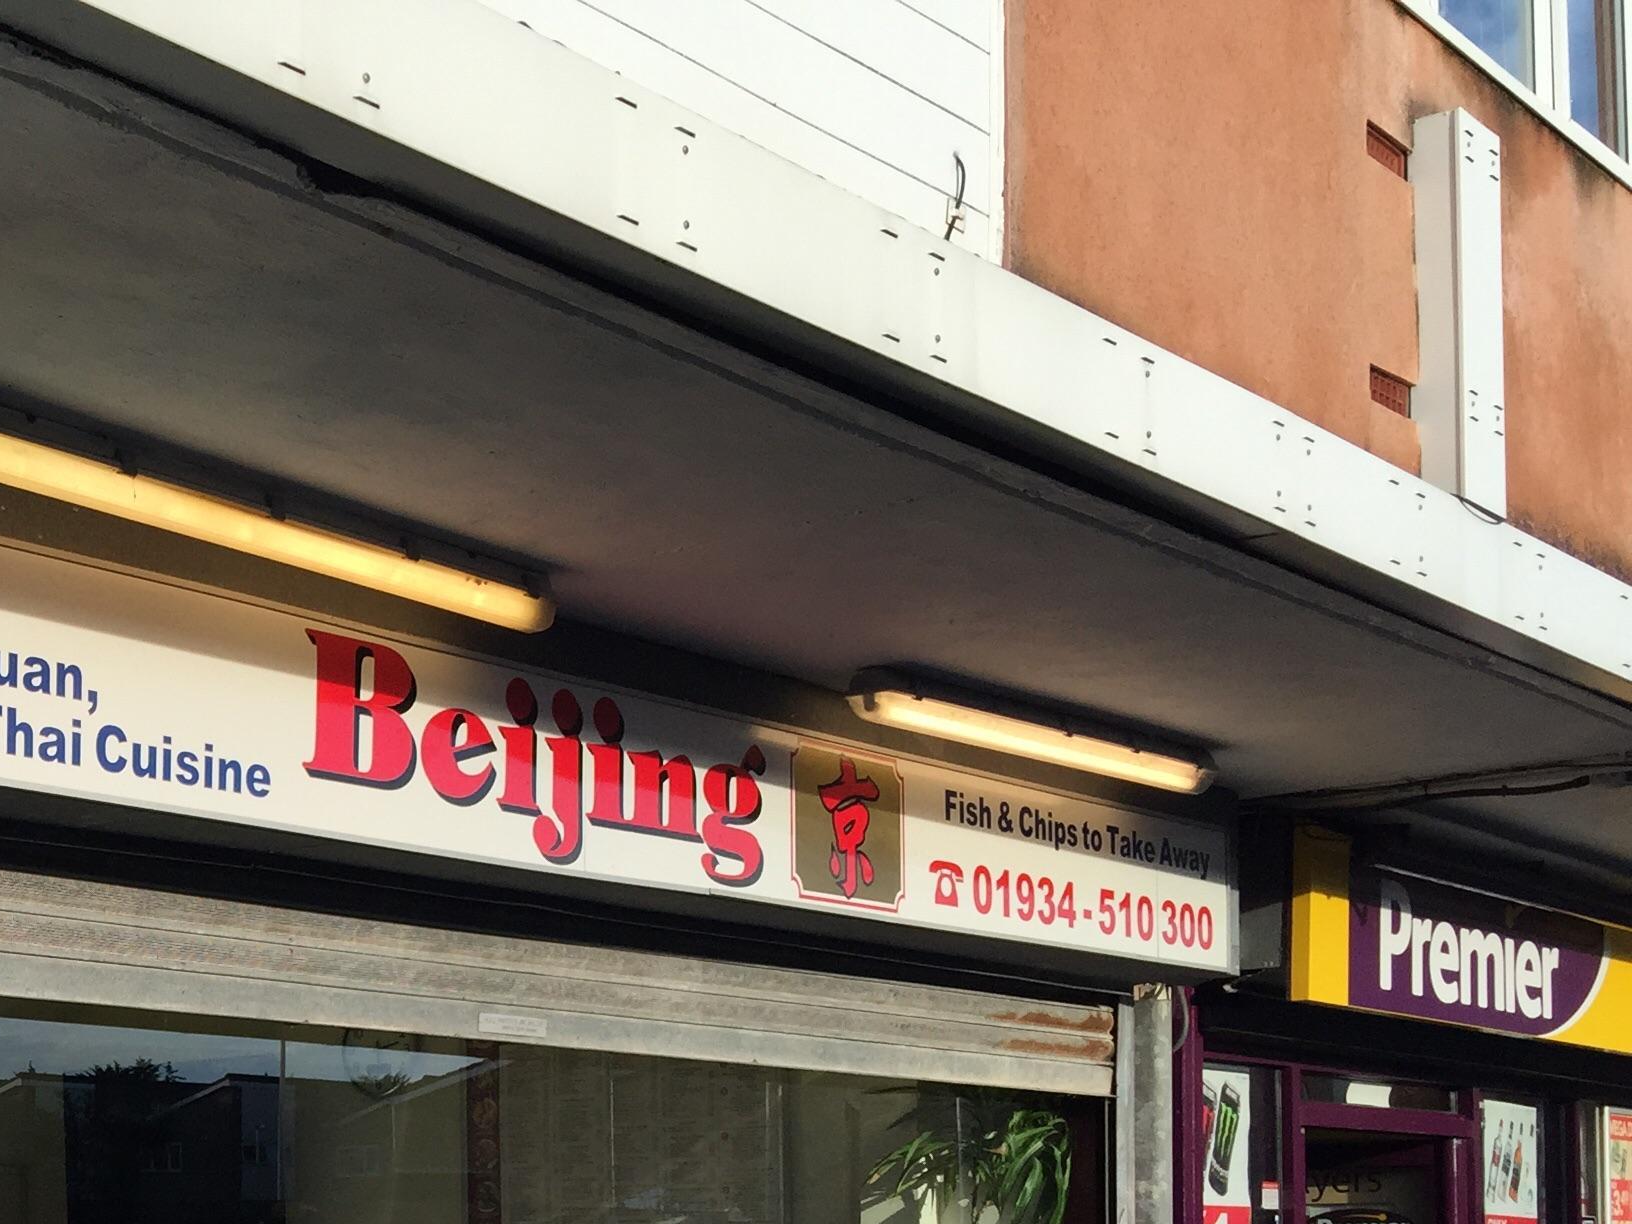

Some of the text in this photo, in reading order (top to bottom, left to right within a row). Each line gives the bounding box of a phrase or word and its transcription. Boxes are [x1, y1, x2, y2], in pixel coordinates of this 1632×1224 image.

[95, 724, 272, 798] Cuisine
[302, 628, 767, 888] Beijing
[818, 754, 881, 900] 京
[944, 789, 1211, 880] Fish & Chips to Take Away
[1161, 900, 1214, 951] 300
[1379, 878, 1560, 1020] Premier
